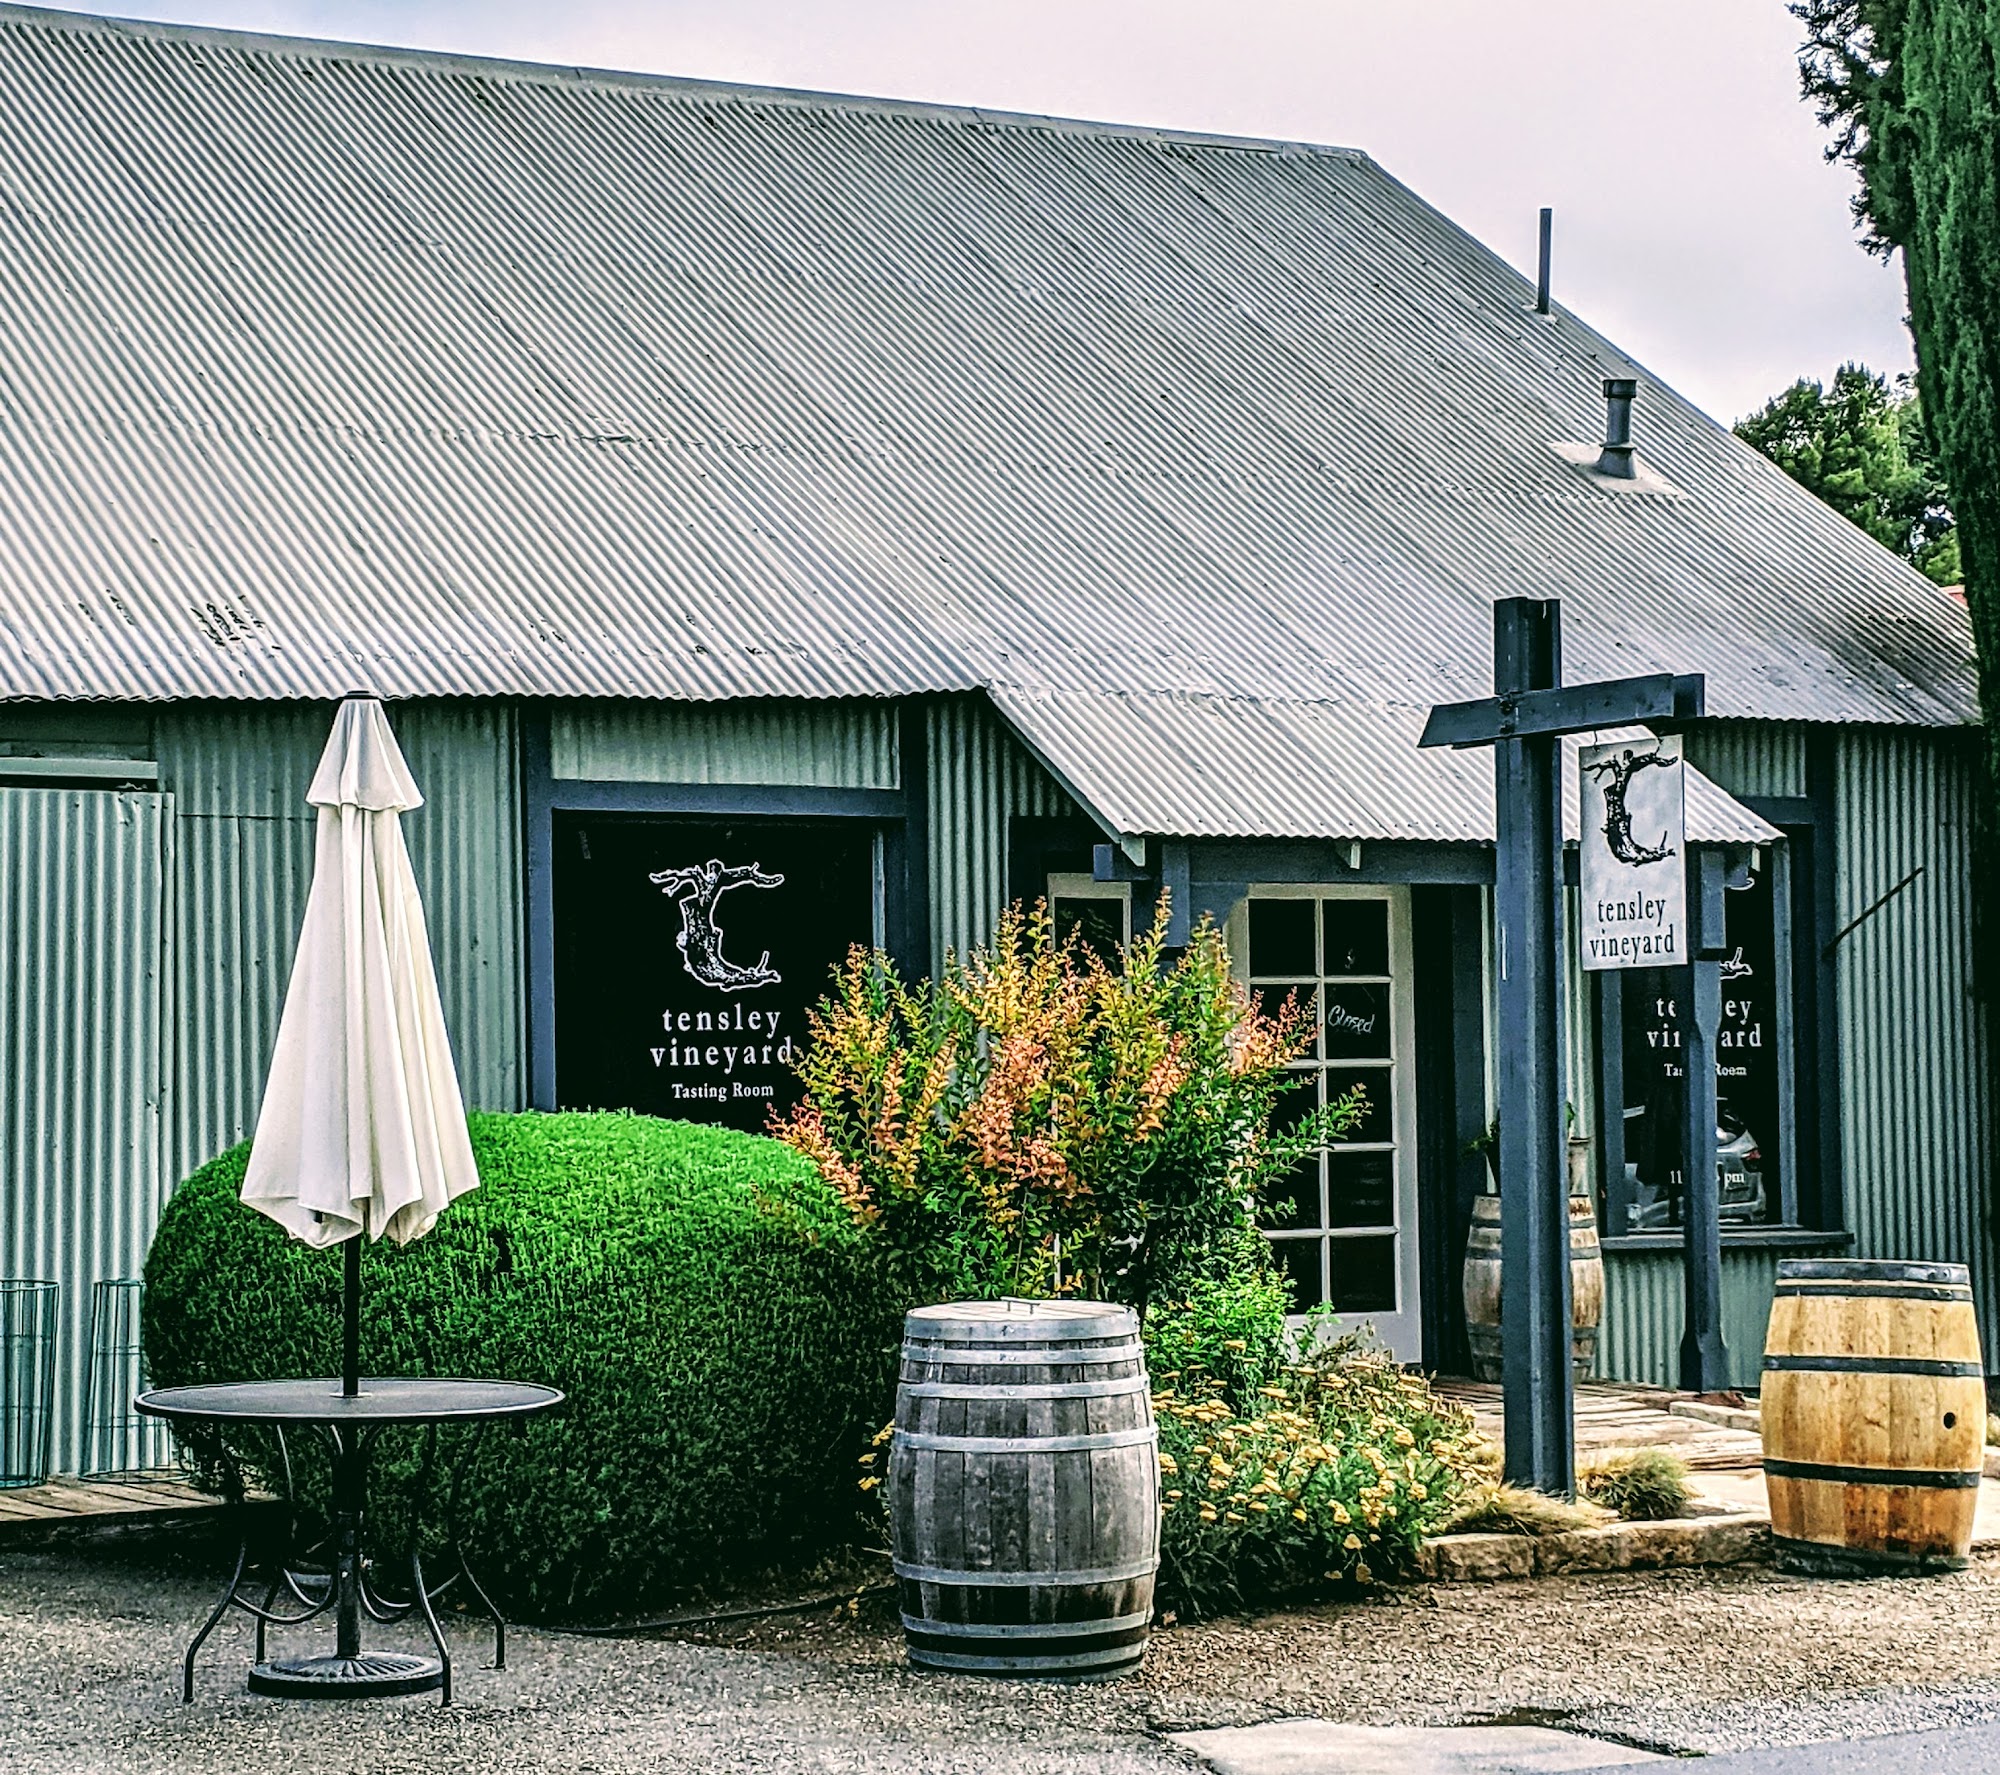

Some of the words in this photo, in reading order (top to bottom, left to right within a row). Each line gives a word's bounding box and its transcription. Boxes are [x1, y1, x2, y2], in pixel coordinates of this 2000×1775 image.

[1598, 890, 1666, 928] tensley
[1589, 922, 1676, 964] vineyard
[662, 1002, 781, 1039] tensley
[1328, 1004, 1375, 1034] Closed
[1656, 998, 1752, 1026] teey
[1646, 1022, 1763, 1048] viard
[650, 1035, 793, 1075] vineyard
[671, 1082, 728, 1102] Tasting
[732, 1081, 775, 1098] Room
[1724, 1173, 1745, 1190] pm
